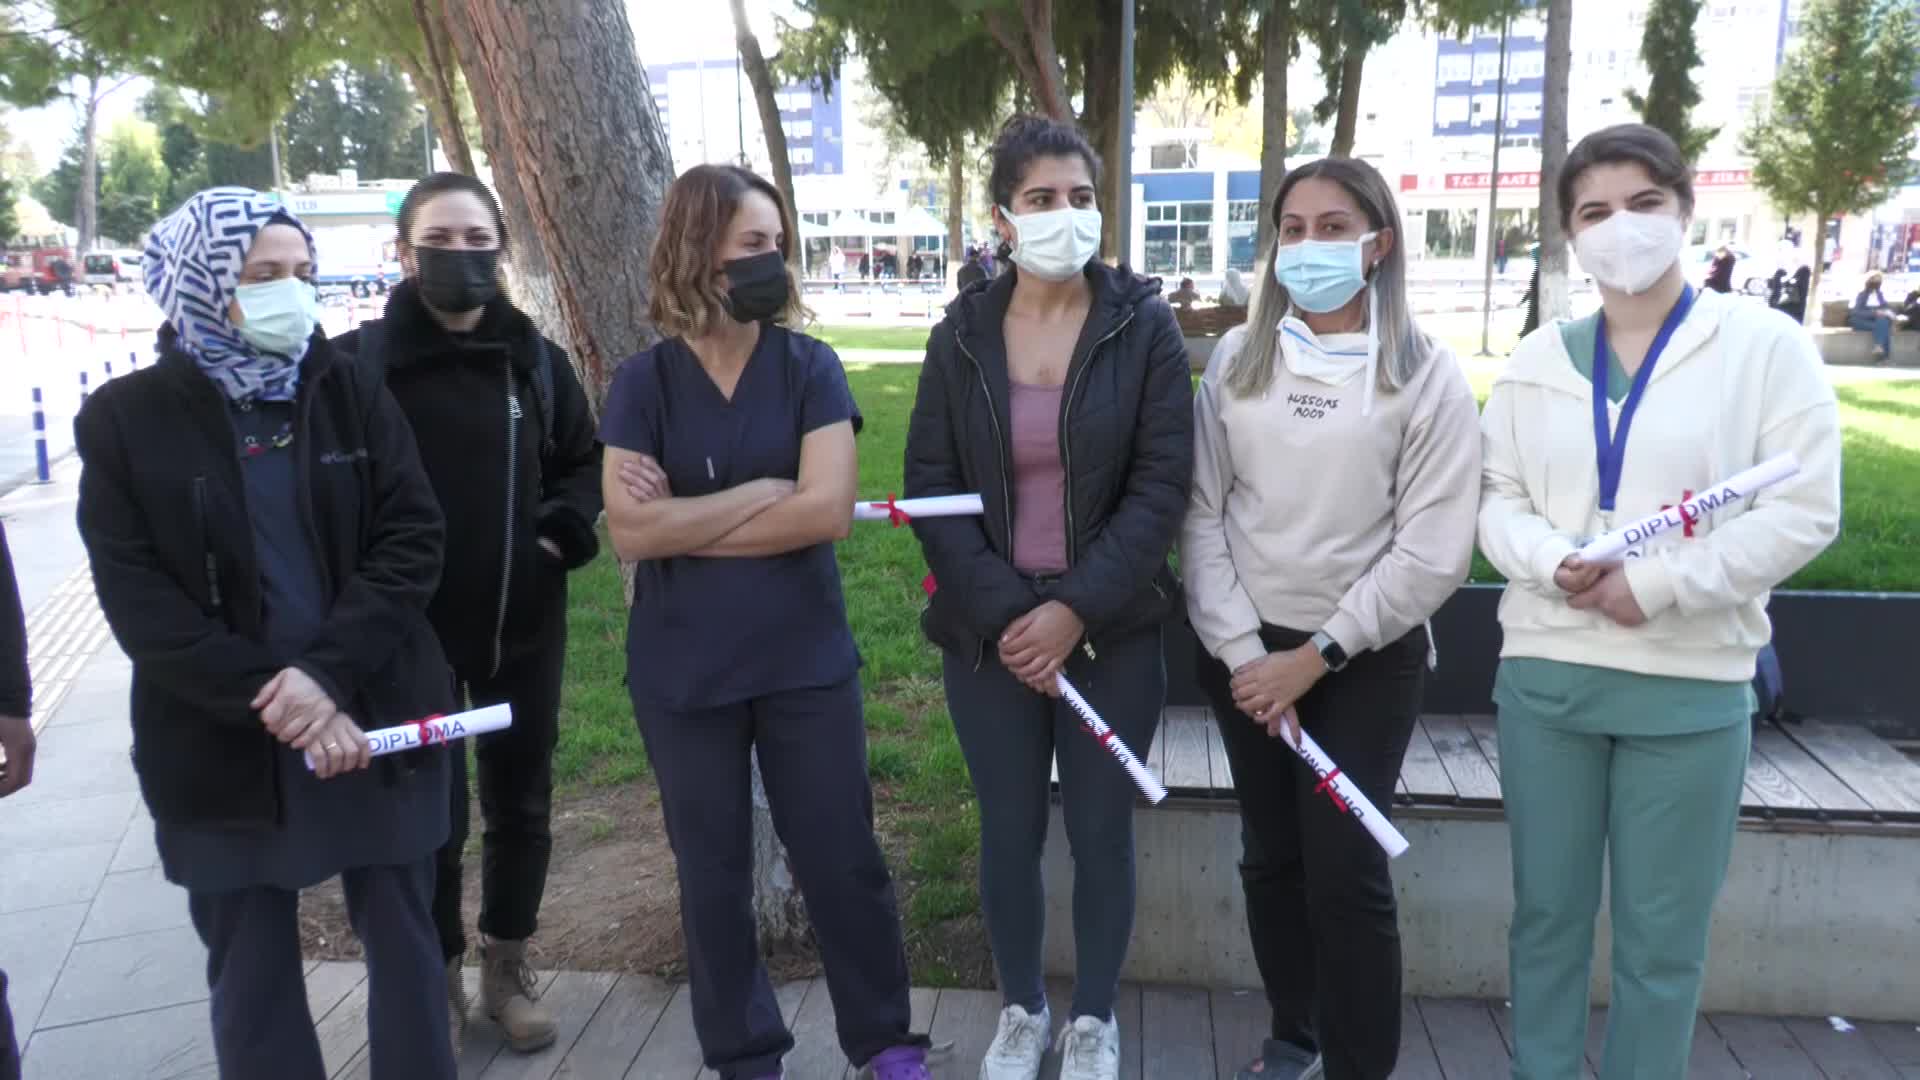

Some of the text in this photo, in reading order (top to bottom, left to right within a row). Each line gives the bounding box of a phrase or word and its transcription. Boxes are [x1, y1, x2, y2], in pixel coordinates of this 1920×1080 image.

[1477, 174, 1527, 186] ZIAAT
[1293, 407, 1325, 419] MOOD
[1624, 487, 1740, 545] DIPLOMA
[368, 720, 465, 752] DIPLOMA
